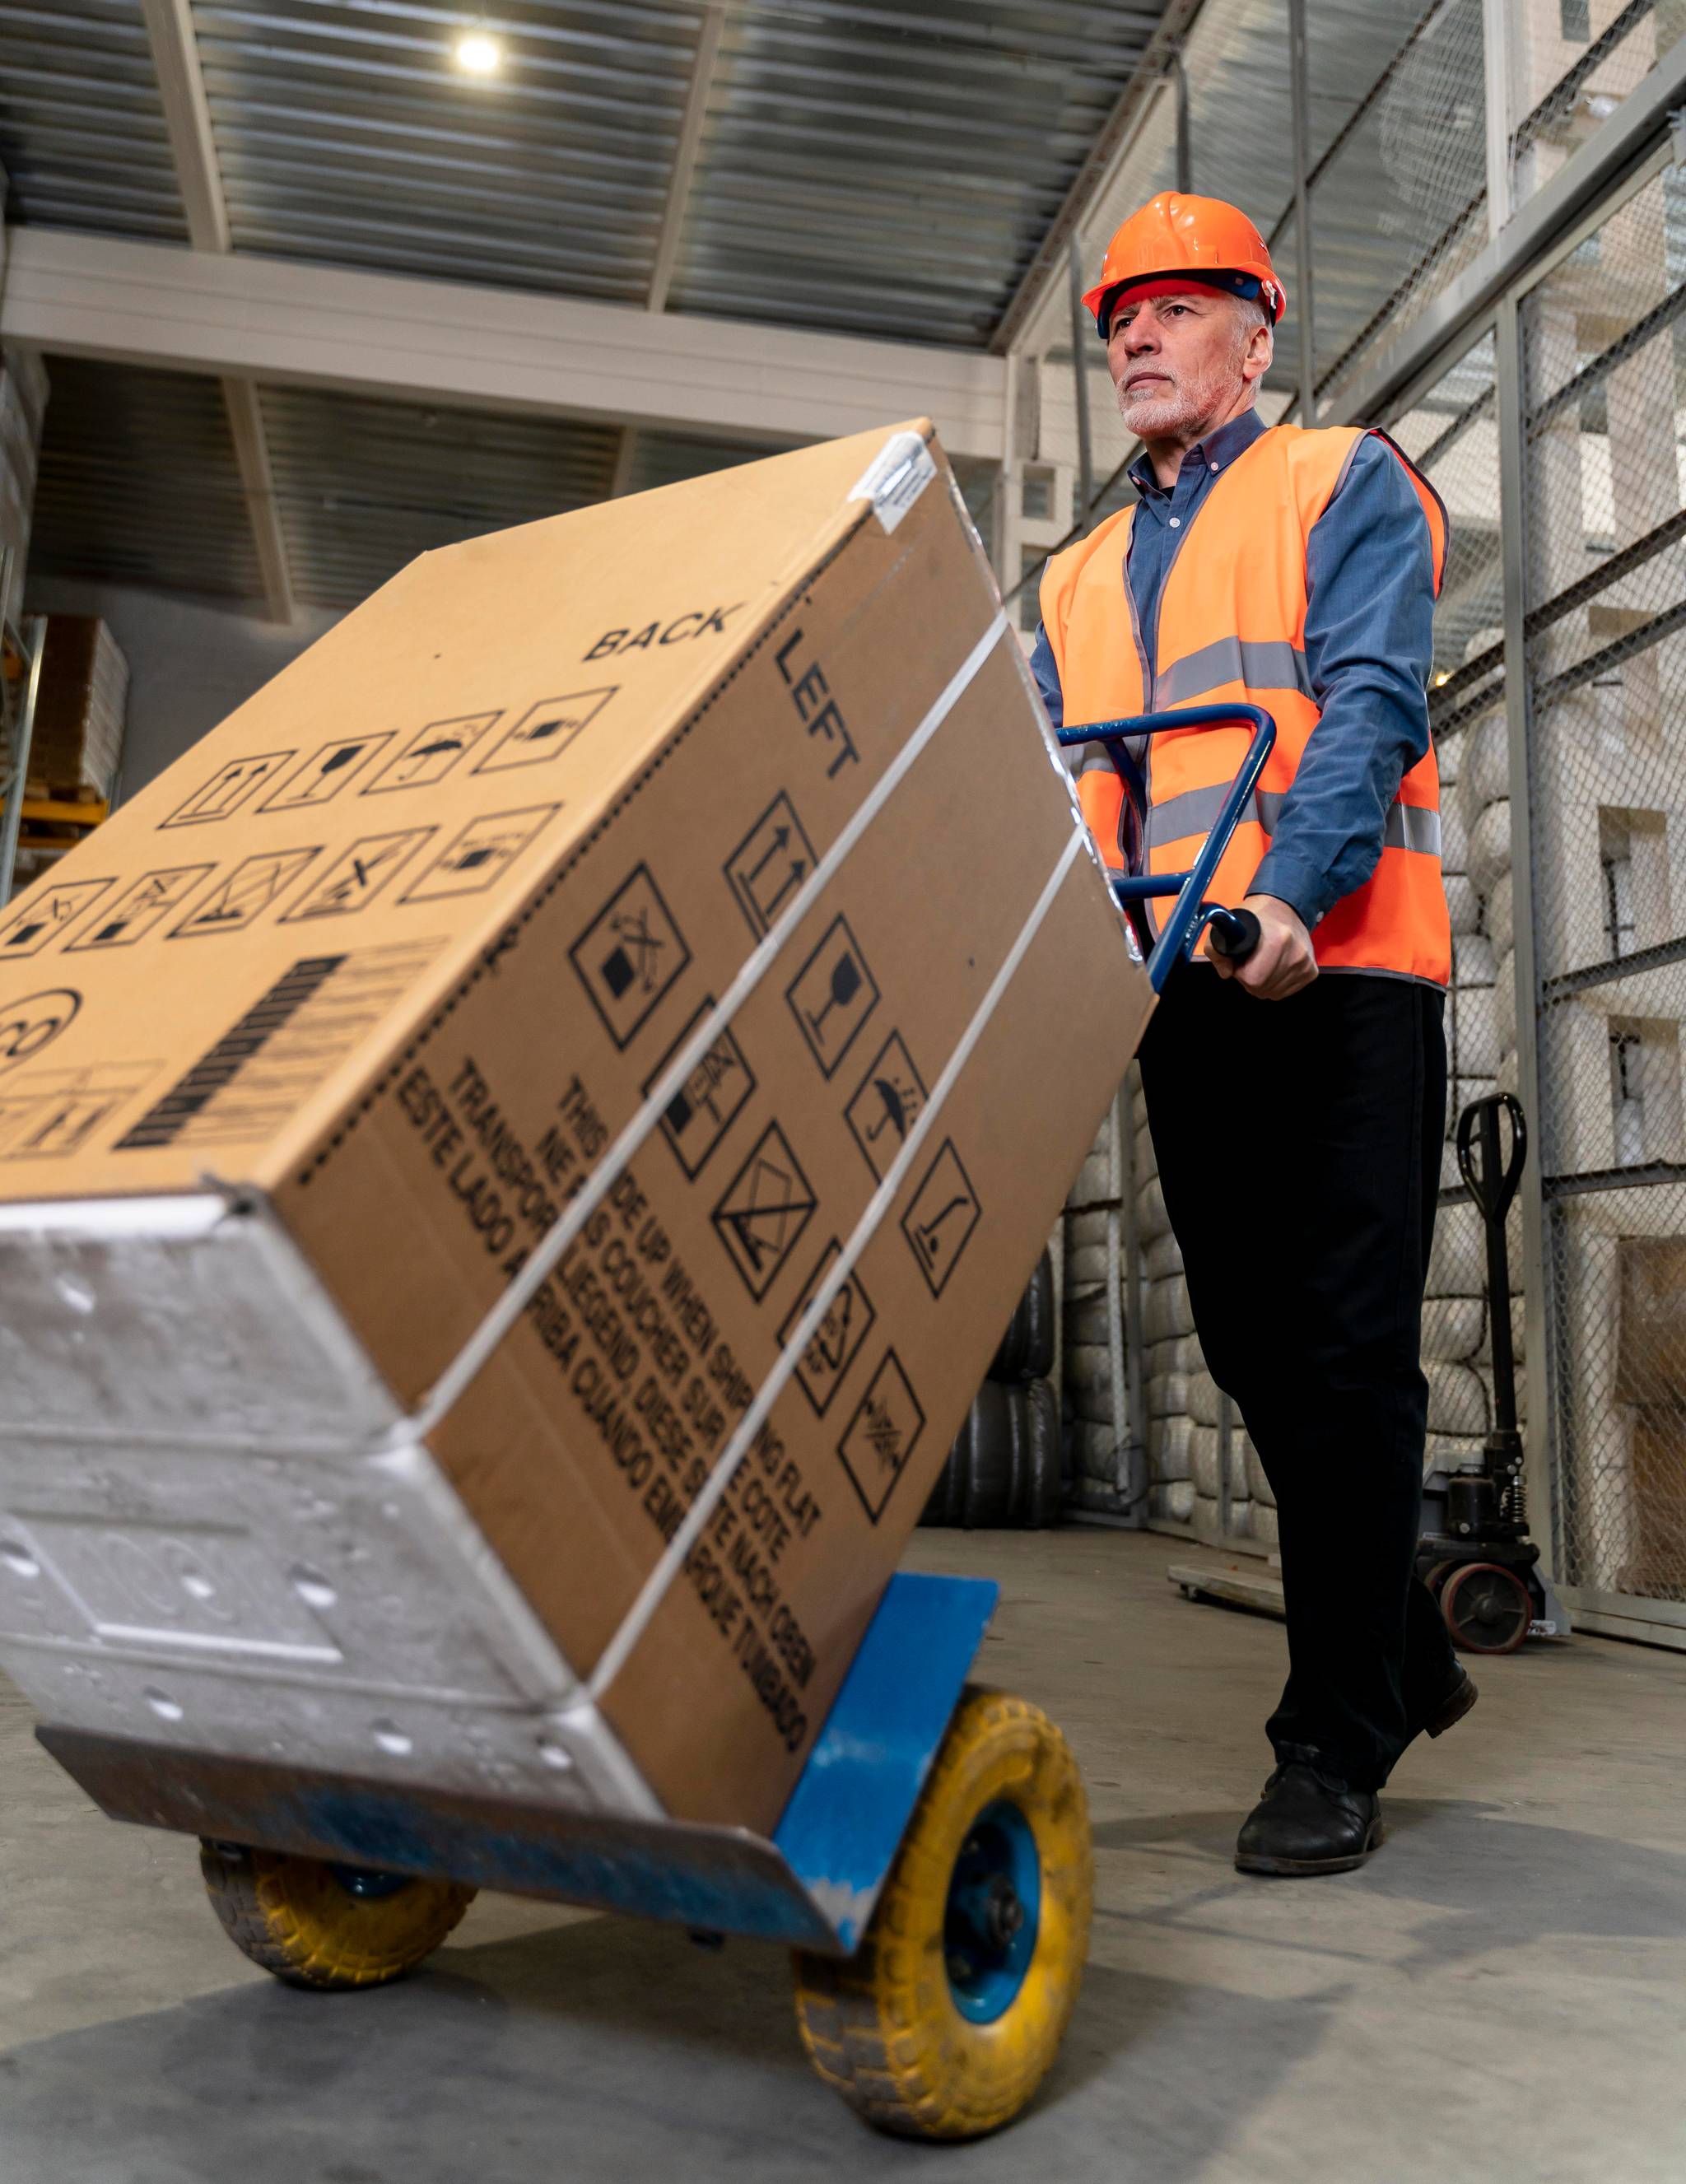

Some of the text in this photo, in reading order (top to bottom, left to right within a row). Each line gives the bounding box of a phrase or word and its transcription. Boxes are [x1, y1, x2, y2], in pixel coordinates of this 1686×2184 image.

[581, 602, 746, 662] BACK
[775, 627, 860, 780] LEFT
[397, 1068, 463, 1167] ESTE
[447, 1154, 515, 1256] LADO
[571, 1357, 653, 1490] CUANDO
[732, 1616, 808, 1753] TUMBADO
[450, 1058, 559, 1241] TRANSPOR
[632, 1376, 694, 1474] DIESE
[729, 1533, 780, 1620] NACH
[770, 1604, 817, 1690] OBEN
[535, 1127, 575, 1185] NE
[600, 1238, 690, 1388] COUCHER
[681, 1376, 726, 1451] SUR
[559, 1075, 608, 1160] THIS
[636, 1217, 672, 1264] UP
[660, 1260, 718, 1357] WHEN
[775, 1461, 822, 1539] FLAT
